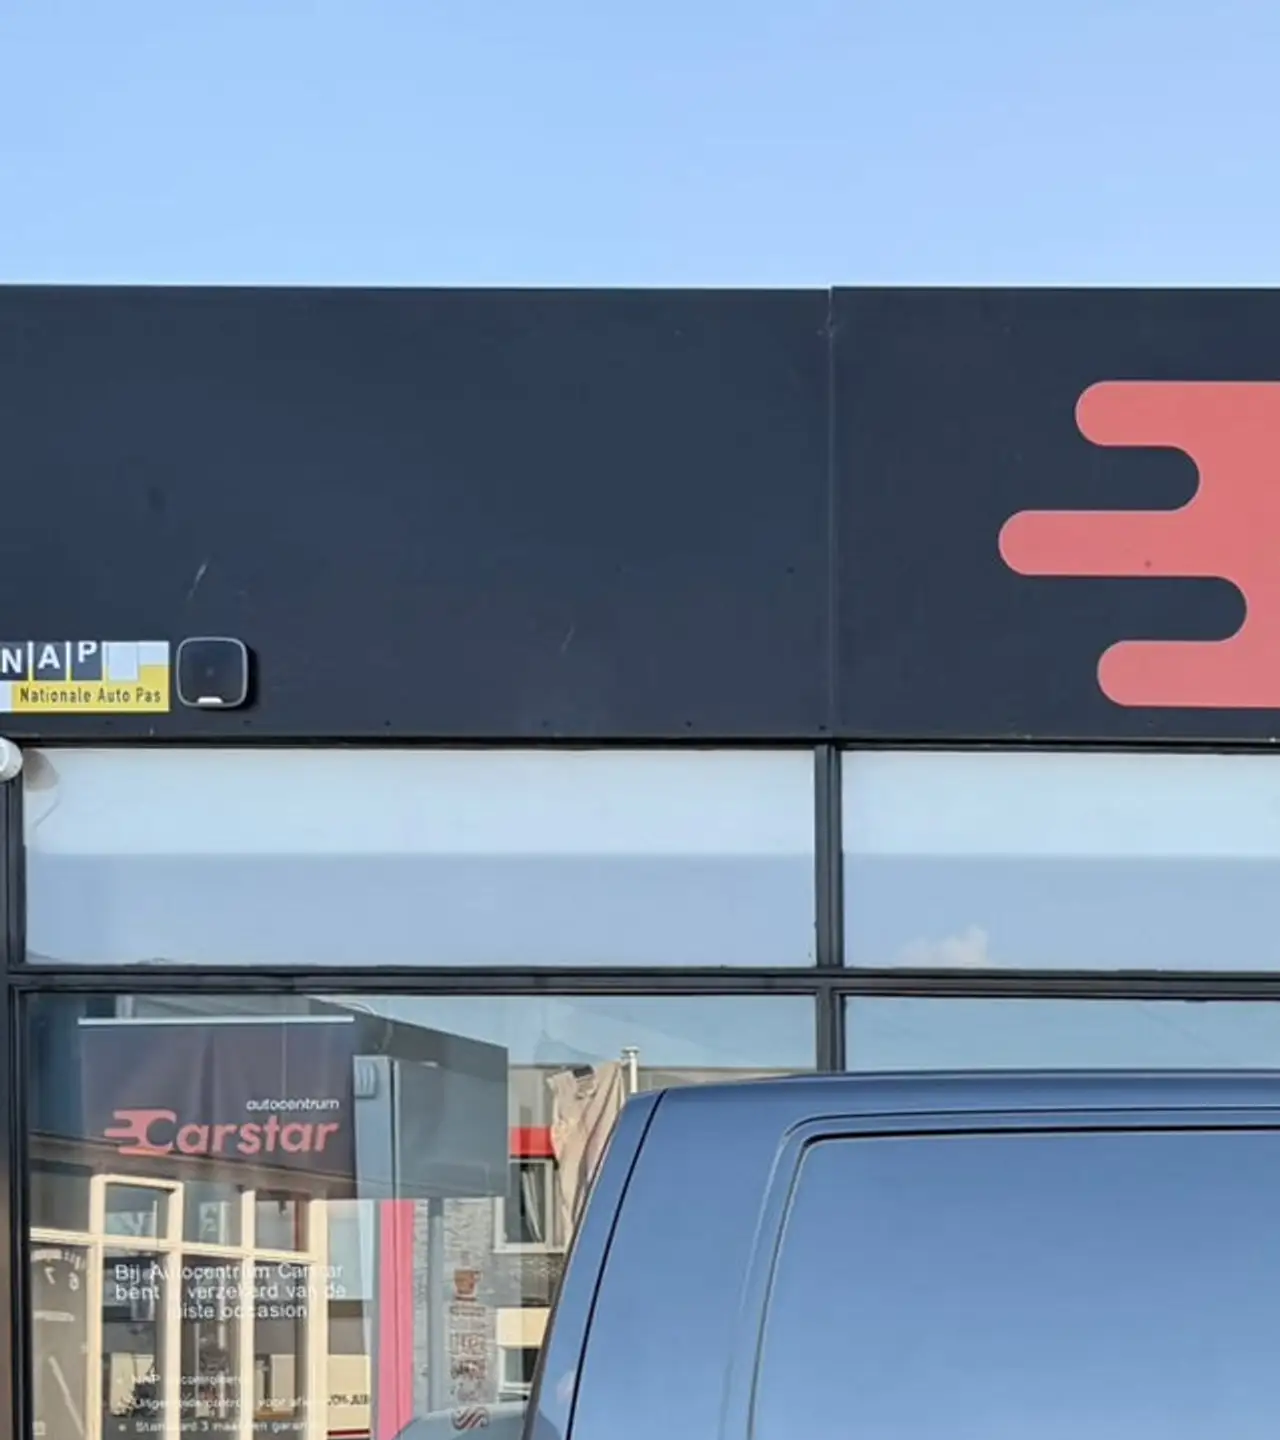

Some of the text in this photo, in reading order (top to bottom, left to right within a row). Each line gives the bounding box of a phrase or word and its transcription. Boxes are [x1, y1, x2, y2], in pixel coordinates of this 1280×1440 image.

[20, 686, 161, 703] Nationale Auto Pas
[246, 1098, 340, 1111] autocentrum
[104, 1109, 339, 1156] Carstar
[115, 1263, 344, 1284] Bij Aocentrm Carar
[115, 1283, 160, 1300] bent
[187, 1284, 279, 1300] verzerd
[222, 1302, 308, 1319] ocasion
